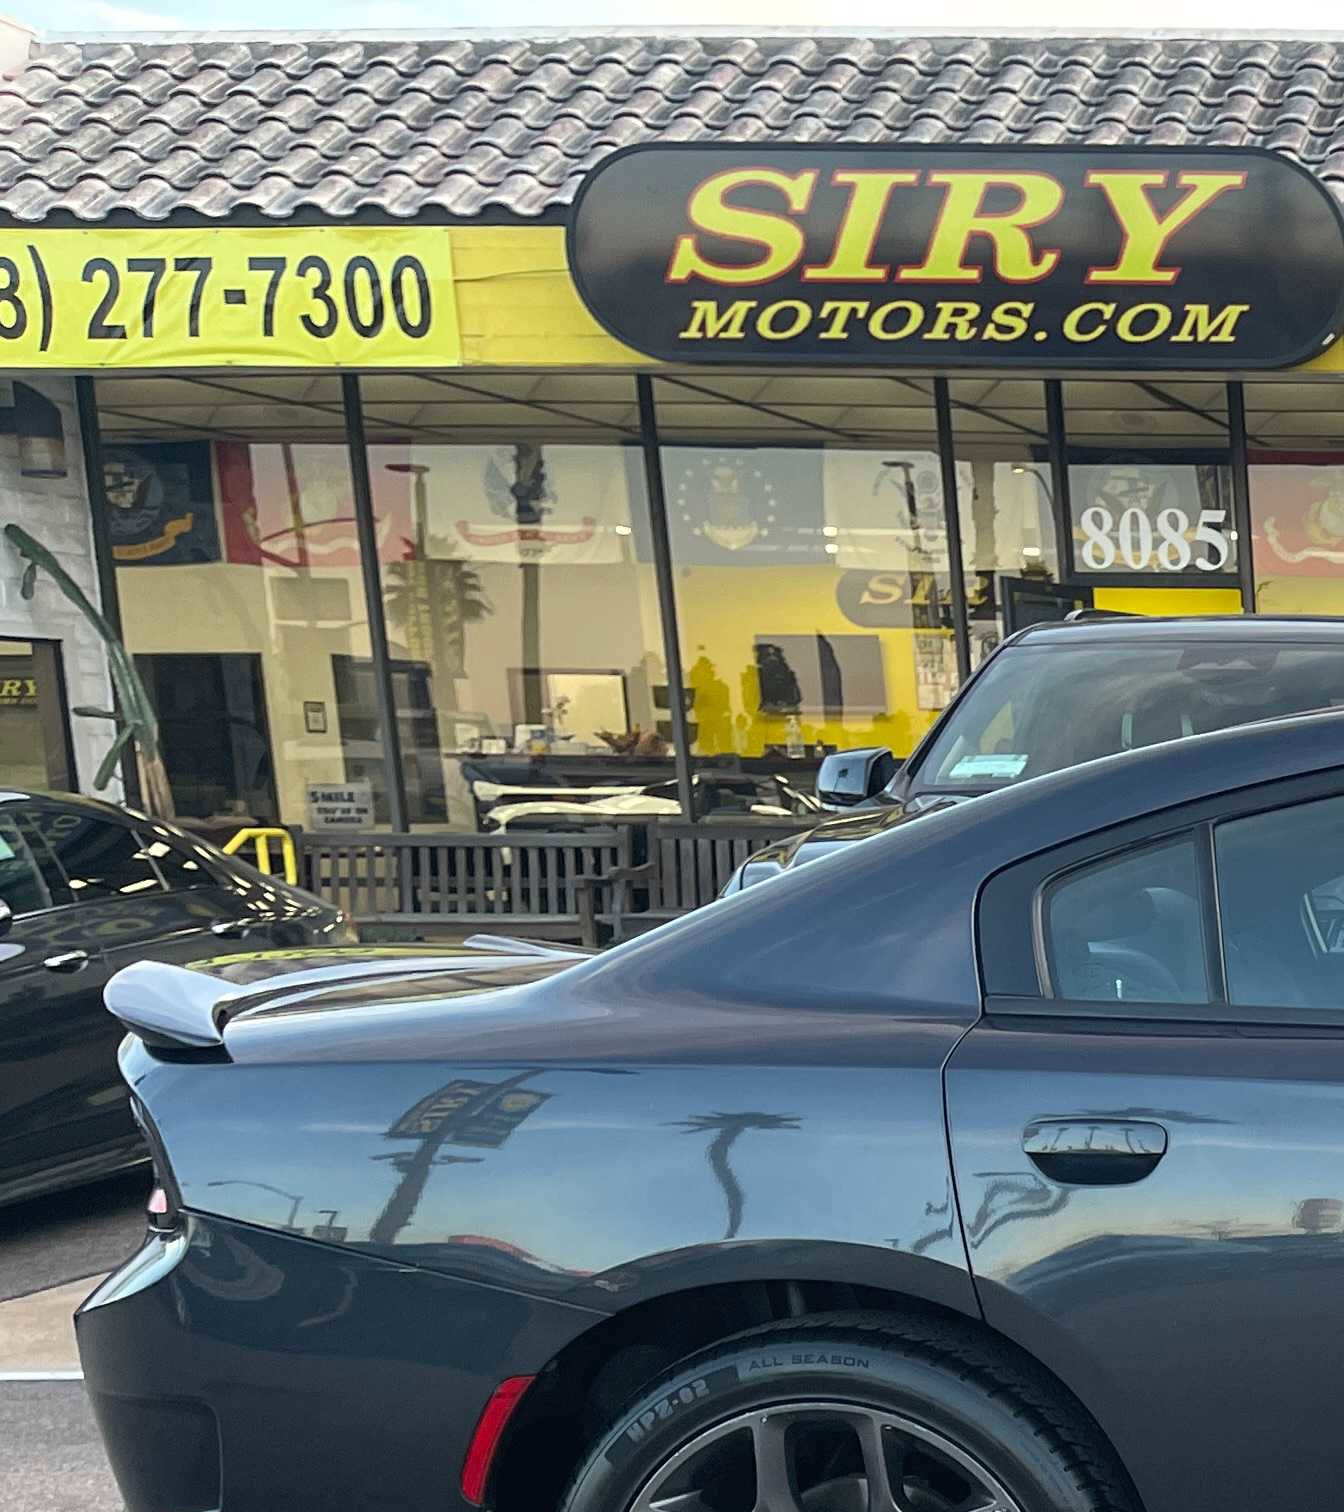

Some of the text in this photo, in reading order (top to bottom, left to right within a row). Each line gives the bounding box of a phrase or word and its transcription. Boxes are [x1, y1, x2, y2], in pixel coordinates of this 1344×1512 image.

[664, 167, 1249, 286] SIRY
[81, 254, 432, 340] 277-7300
[678, 300, 1250, 343] MOTORS.COM
[1080, 506, 1229, 571] 8085
[748, 1357, 784, 1372] ALL
[791, 1353, 870, 1370] SEASON
